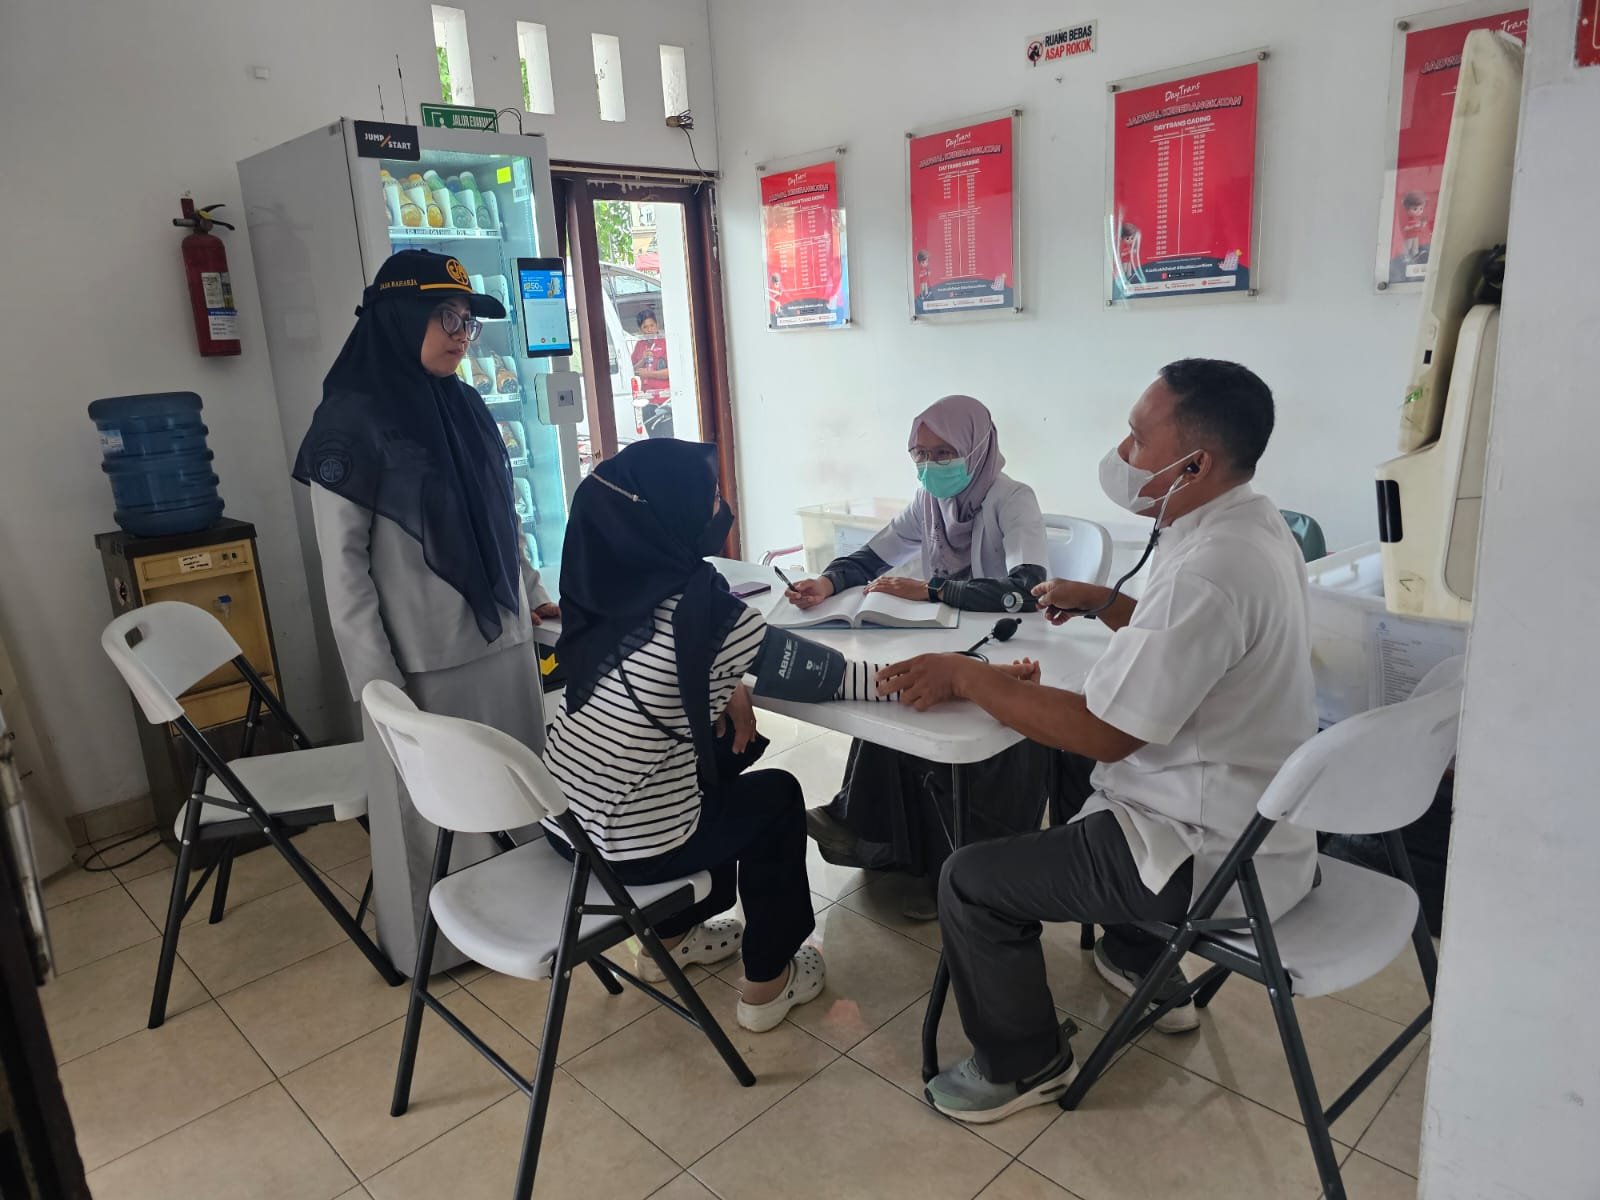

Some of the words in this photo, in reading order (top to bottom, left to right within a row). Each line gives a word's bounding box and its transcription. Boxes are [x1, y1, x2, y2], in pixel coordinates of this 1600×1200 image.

[1045, 31, 1068, 47] RUANG
[1069, 25, 1092, 41] BEBAS
[1045, 45, 1065, 61] ASAP
[1066, 38, 1091, 56] ROKOK
[1164, 81, 1201, 103] DayTrans
[364, 132, 384, 142] JUMP
[387, 140, 411, 150] START
[778, 650, 791, 678] ABN
